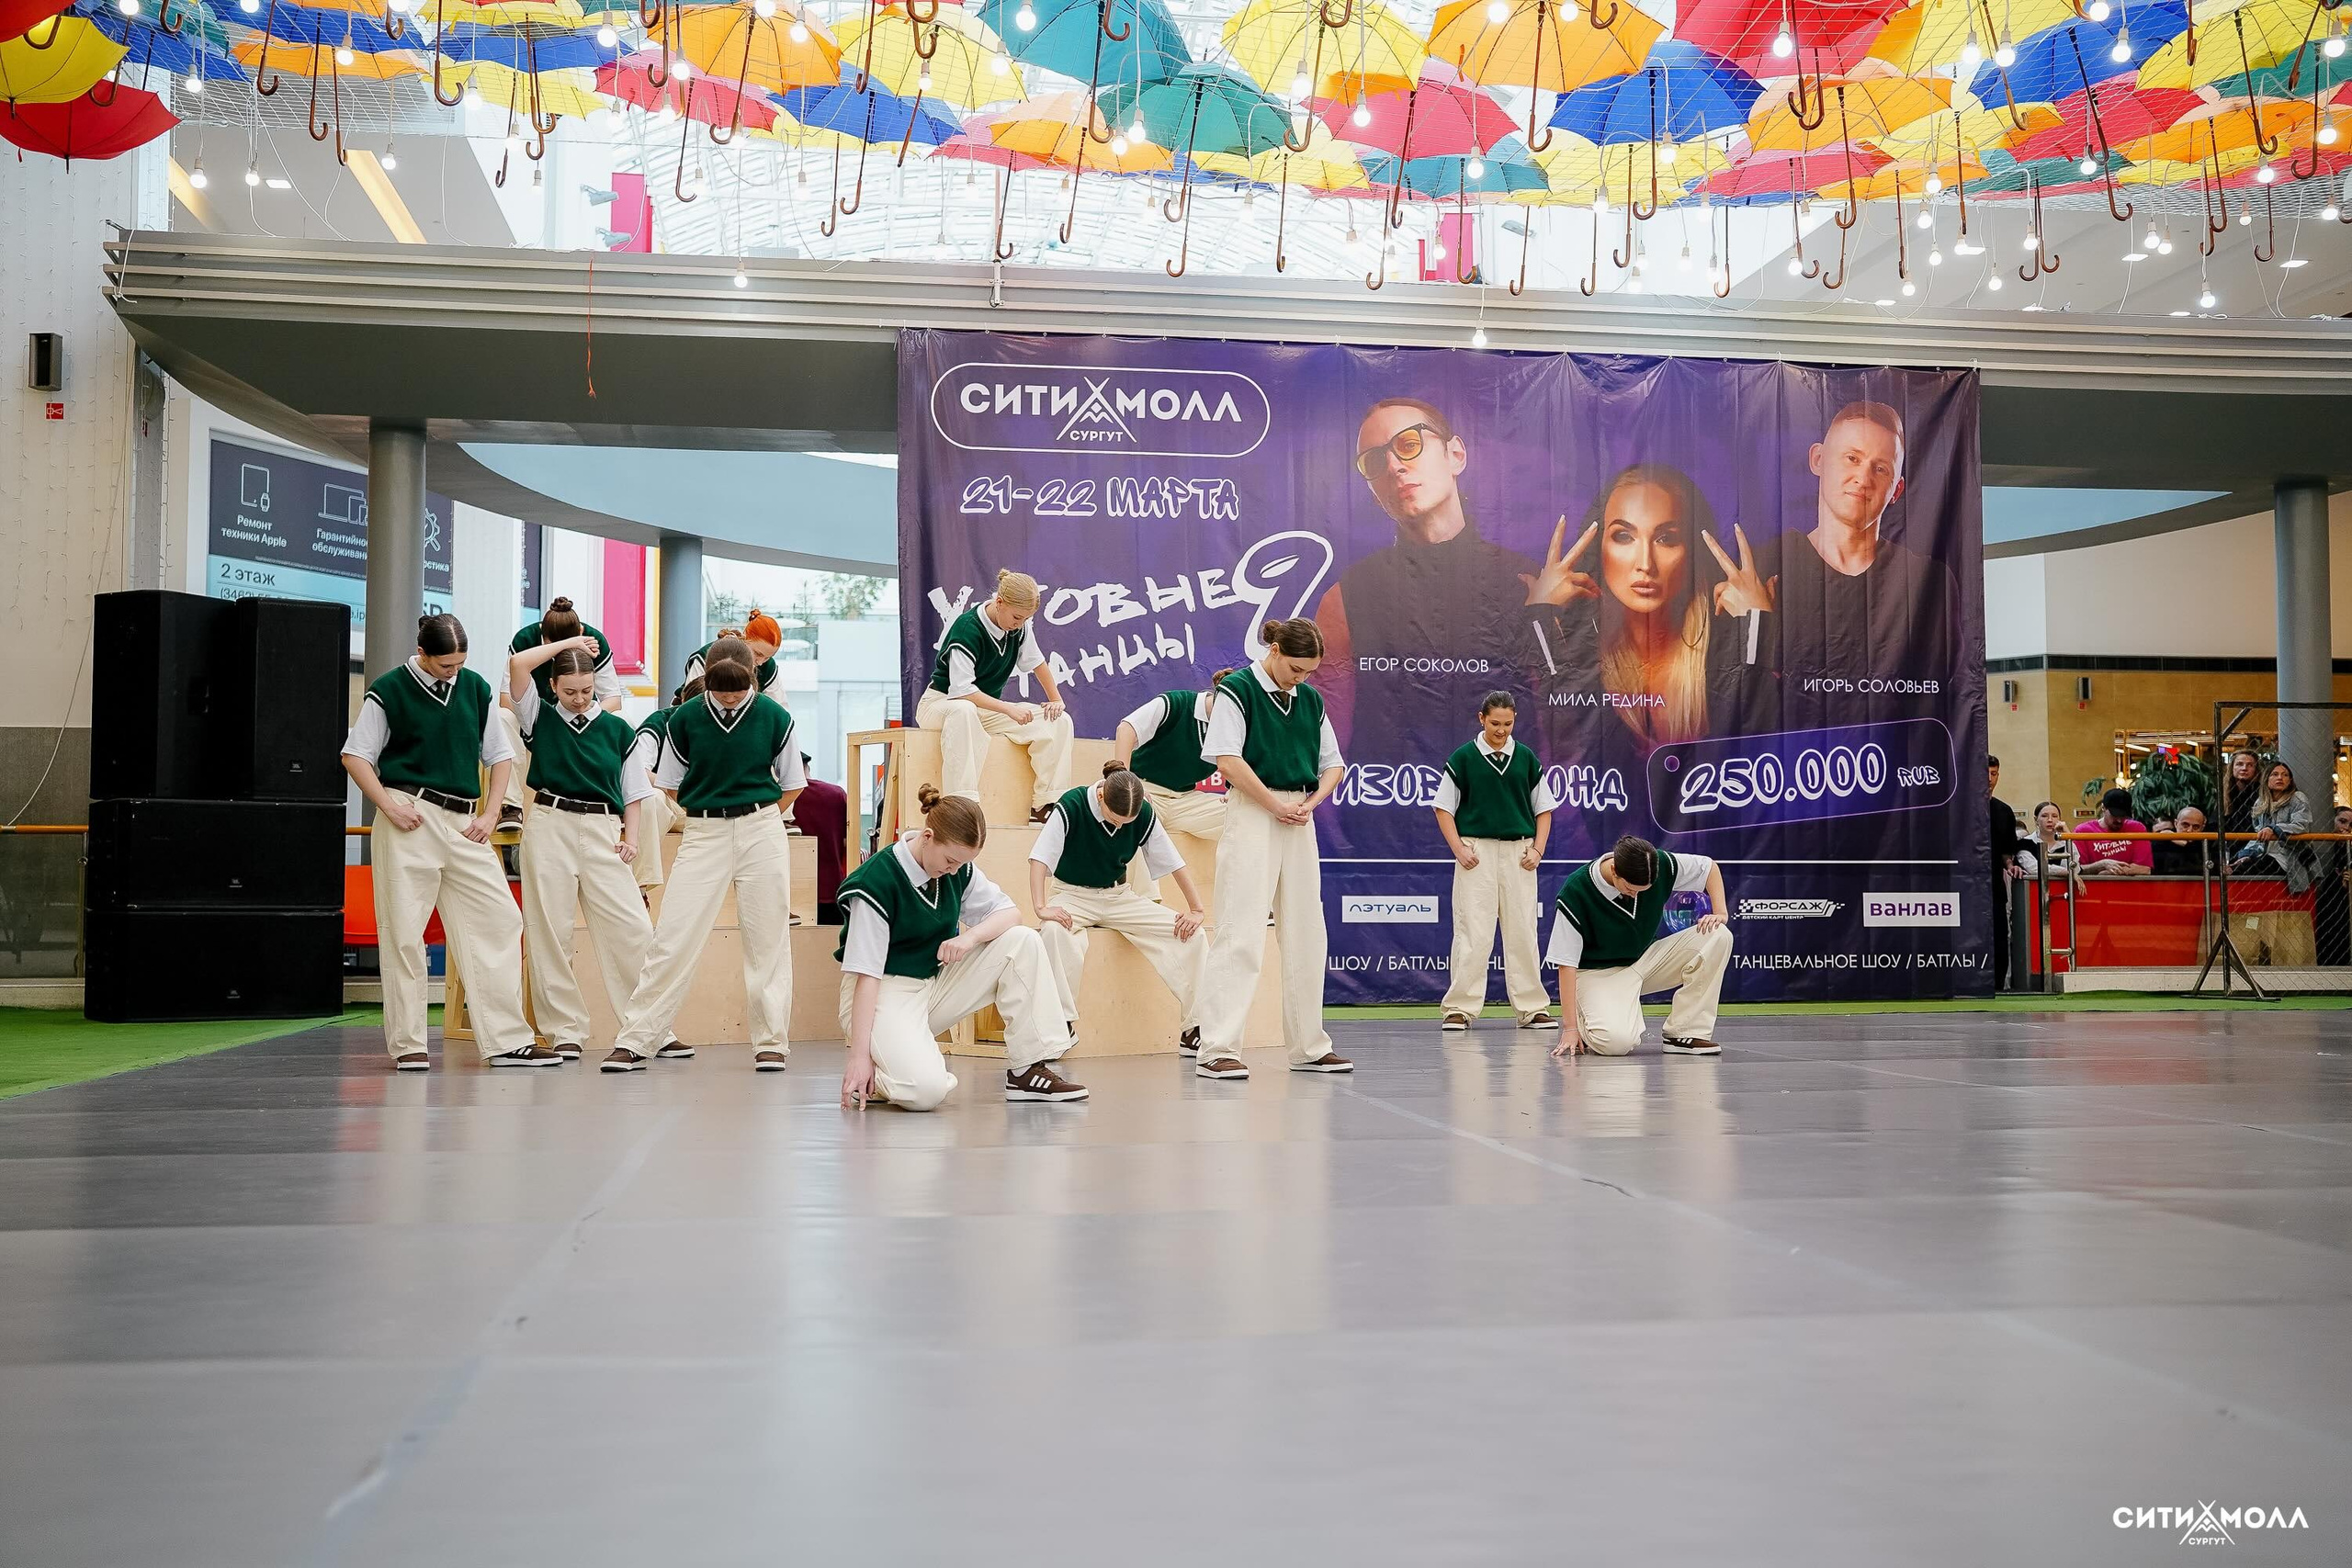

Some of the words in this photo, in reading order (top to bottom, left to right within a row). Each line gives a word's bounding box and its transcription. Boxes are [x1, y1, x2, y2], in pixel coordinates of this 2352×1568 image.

[960, 382, 1078, 416] СИТИ
[1115, 387, 1242, 423] МОЛЛ
[1069, 430, 1124, 443] СУРГУТ
[959, 474, 1098, 516] 21-22
[1106, 476, 1239, 521] МАРТА
[237, 514, 273, 532] Ремонт
[220, 526, 260, 543] техники
[261, 534, 288, 548] Apple
[311, 542, 368, 561] обслуживан
[220, 563, 231, 580] 2
[234, 569, 276, 587] этаж
[928, 568, 1237, 650] ХОВЫЕ
[1359, 658, 1399, 671] ЕГОР
[1403, 658, 1489, 673] СОКОЛОВ
[1804, 678, 1854, 694] ИГОРЬ
[1858, 679, 1940, 694] СОЛОВЬЕВ
[1548, 693, 1598, 707] МИЛА
[1602, 694, 1667, 708] РЕДИНА
[1679, 742, 1887, 814] 250.000
[1896, 764, 1940, 787] RUB
[1546, 763, 1629, 812] ОНД
[1754, 901, 1824, 911] ФОРСАЖ
[1870, 902, 1953, 917] ванлав
[1329, 956, 1372, 971] ШОУ
[1388, 956, 1450, 971] БАТТЛЫ
[1733, 953, 1858, 970] ТАНЦЕВАЛЬНОЕ
[1861, 953, 1902, 969] ШОУ
[1917, 953, 1975, 968] БАТТЛЫ
